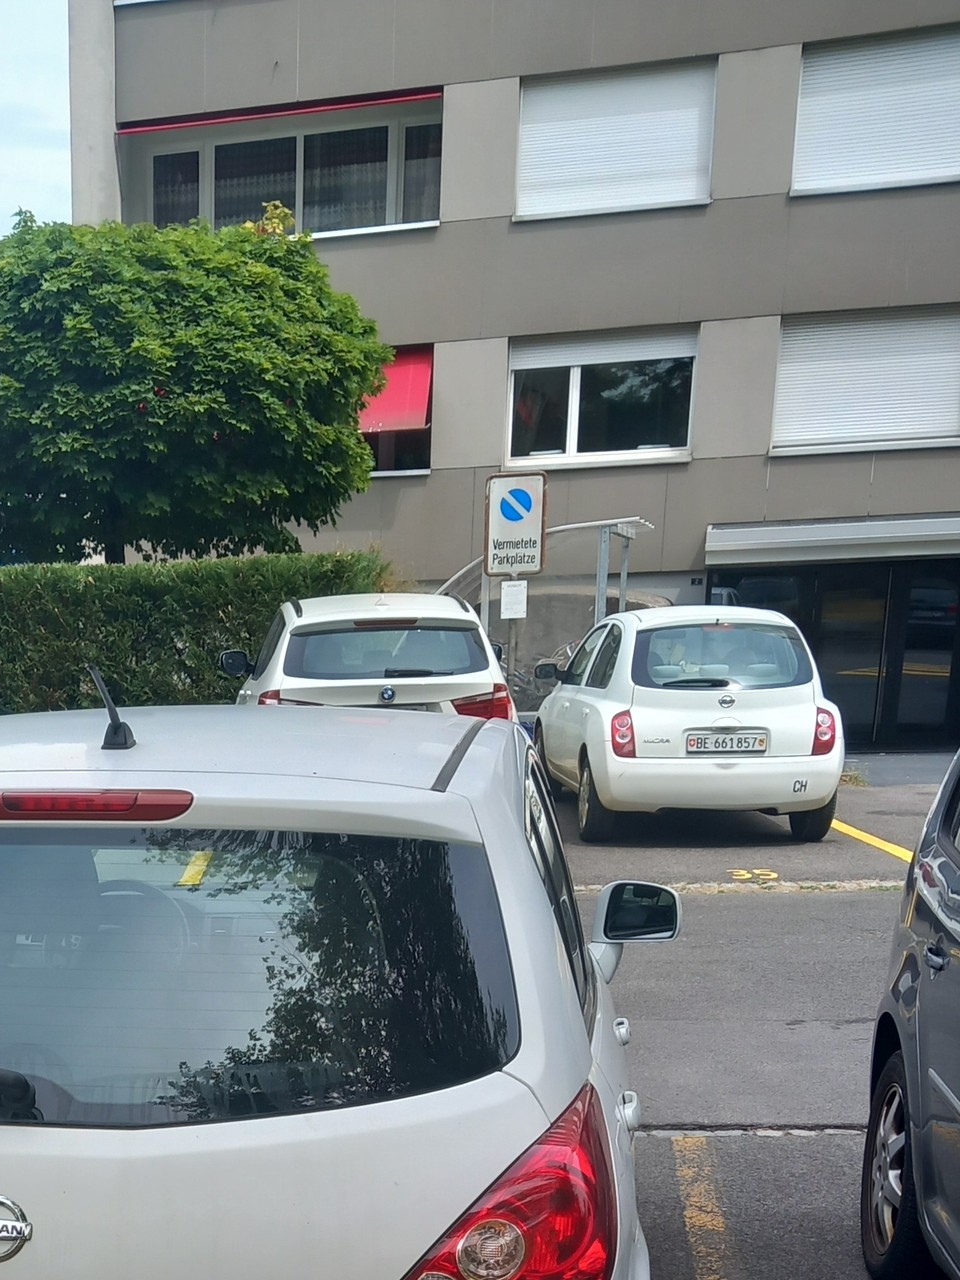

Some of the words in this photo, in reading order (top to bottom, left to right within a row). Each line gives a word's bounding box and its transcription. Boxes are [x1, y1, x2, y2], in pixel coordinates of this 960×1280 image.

[493, 537, 537, 550] Vermietete
[492, 552, 536, 567] Parkplätze
[696, 737, 709, 750] BE
[714, 737, 758, 750] 661857
[793, 780, 808, 793] CH
[726, 869, 779, 879] 35
